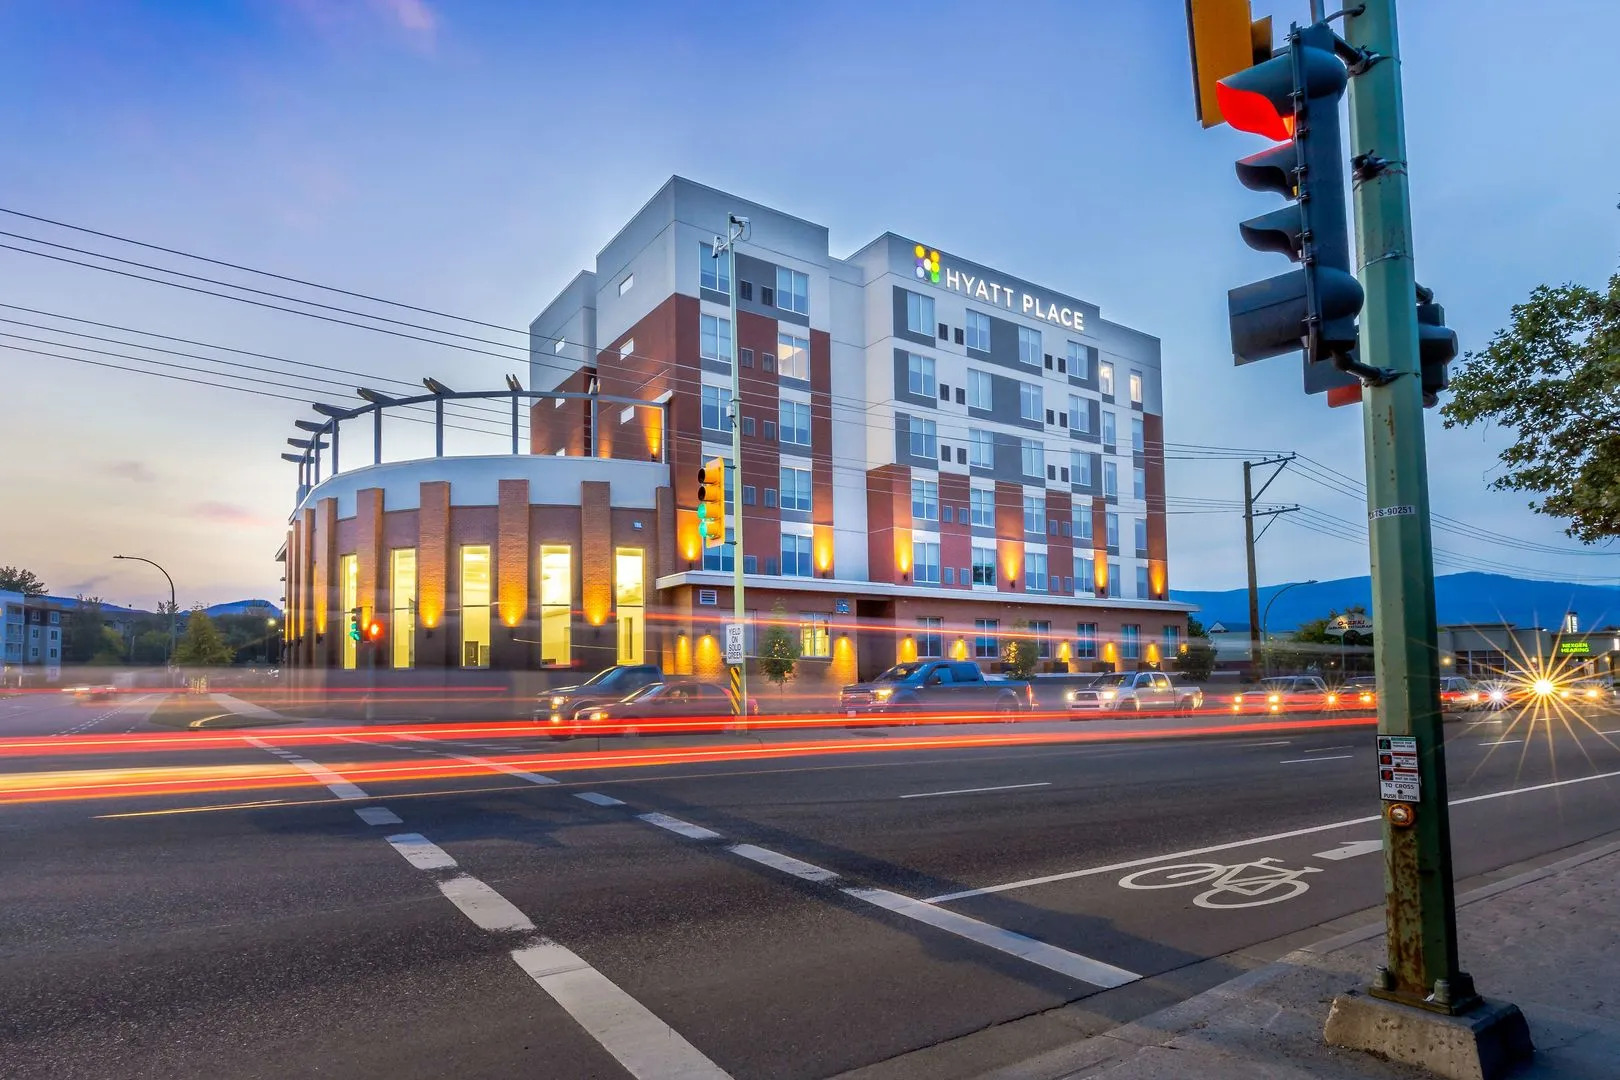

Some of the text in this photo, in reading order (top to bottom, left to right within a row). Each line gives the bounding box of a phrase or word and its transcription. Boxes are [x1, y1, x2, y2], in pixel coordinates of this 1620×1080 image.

[946, 268, 1084, 331] HYATT PLACE
[728, 627, 741, 636] YIELD
[731, 635, 739, 644] ON
[728, 643, 742, 652] SOLID
[727, 651, 743, 660] GREEN
